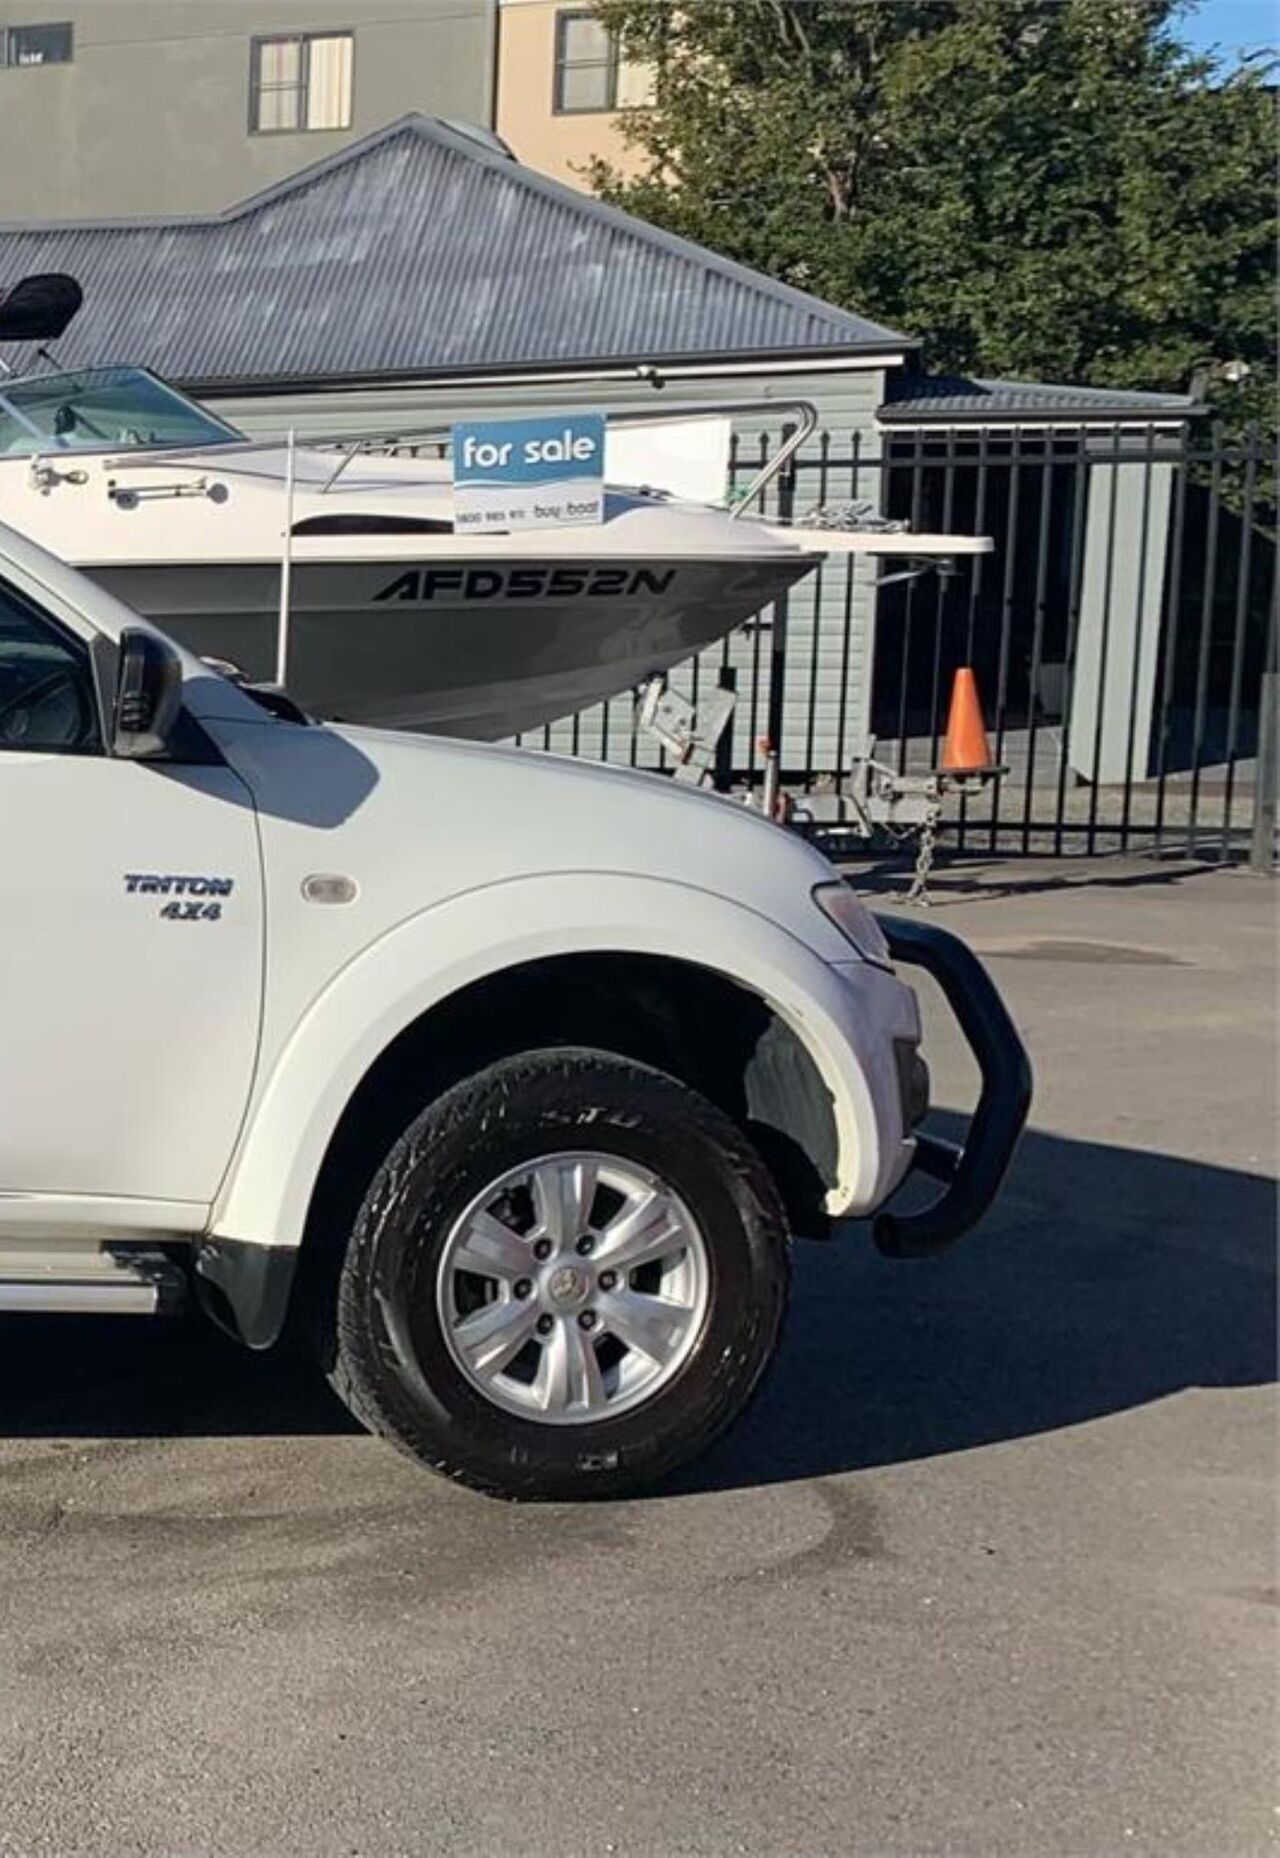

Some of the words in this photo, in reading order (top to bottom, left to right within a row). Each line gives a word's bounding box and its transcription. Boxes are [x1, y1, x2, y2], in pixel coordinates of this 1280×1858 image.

[463, 436, 512, 468] for
[524, 429, 596, 464] sale
[372, 568, 676, 600] AFD552N
[124, 874, 233, 896] TRITON
